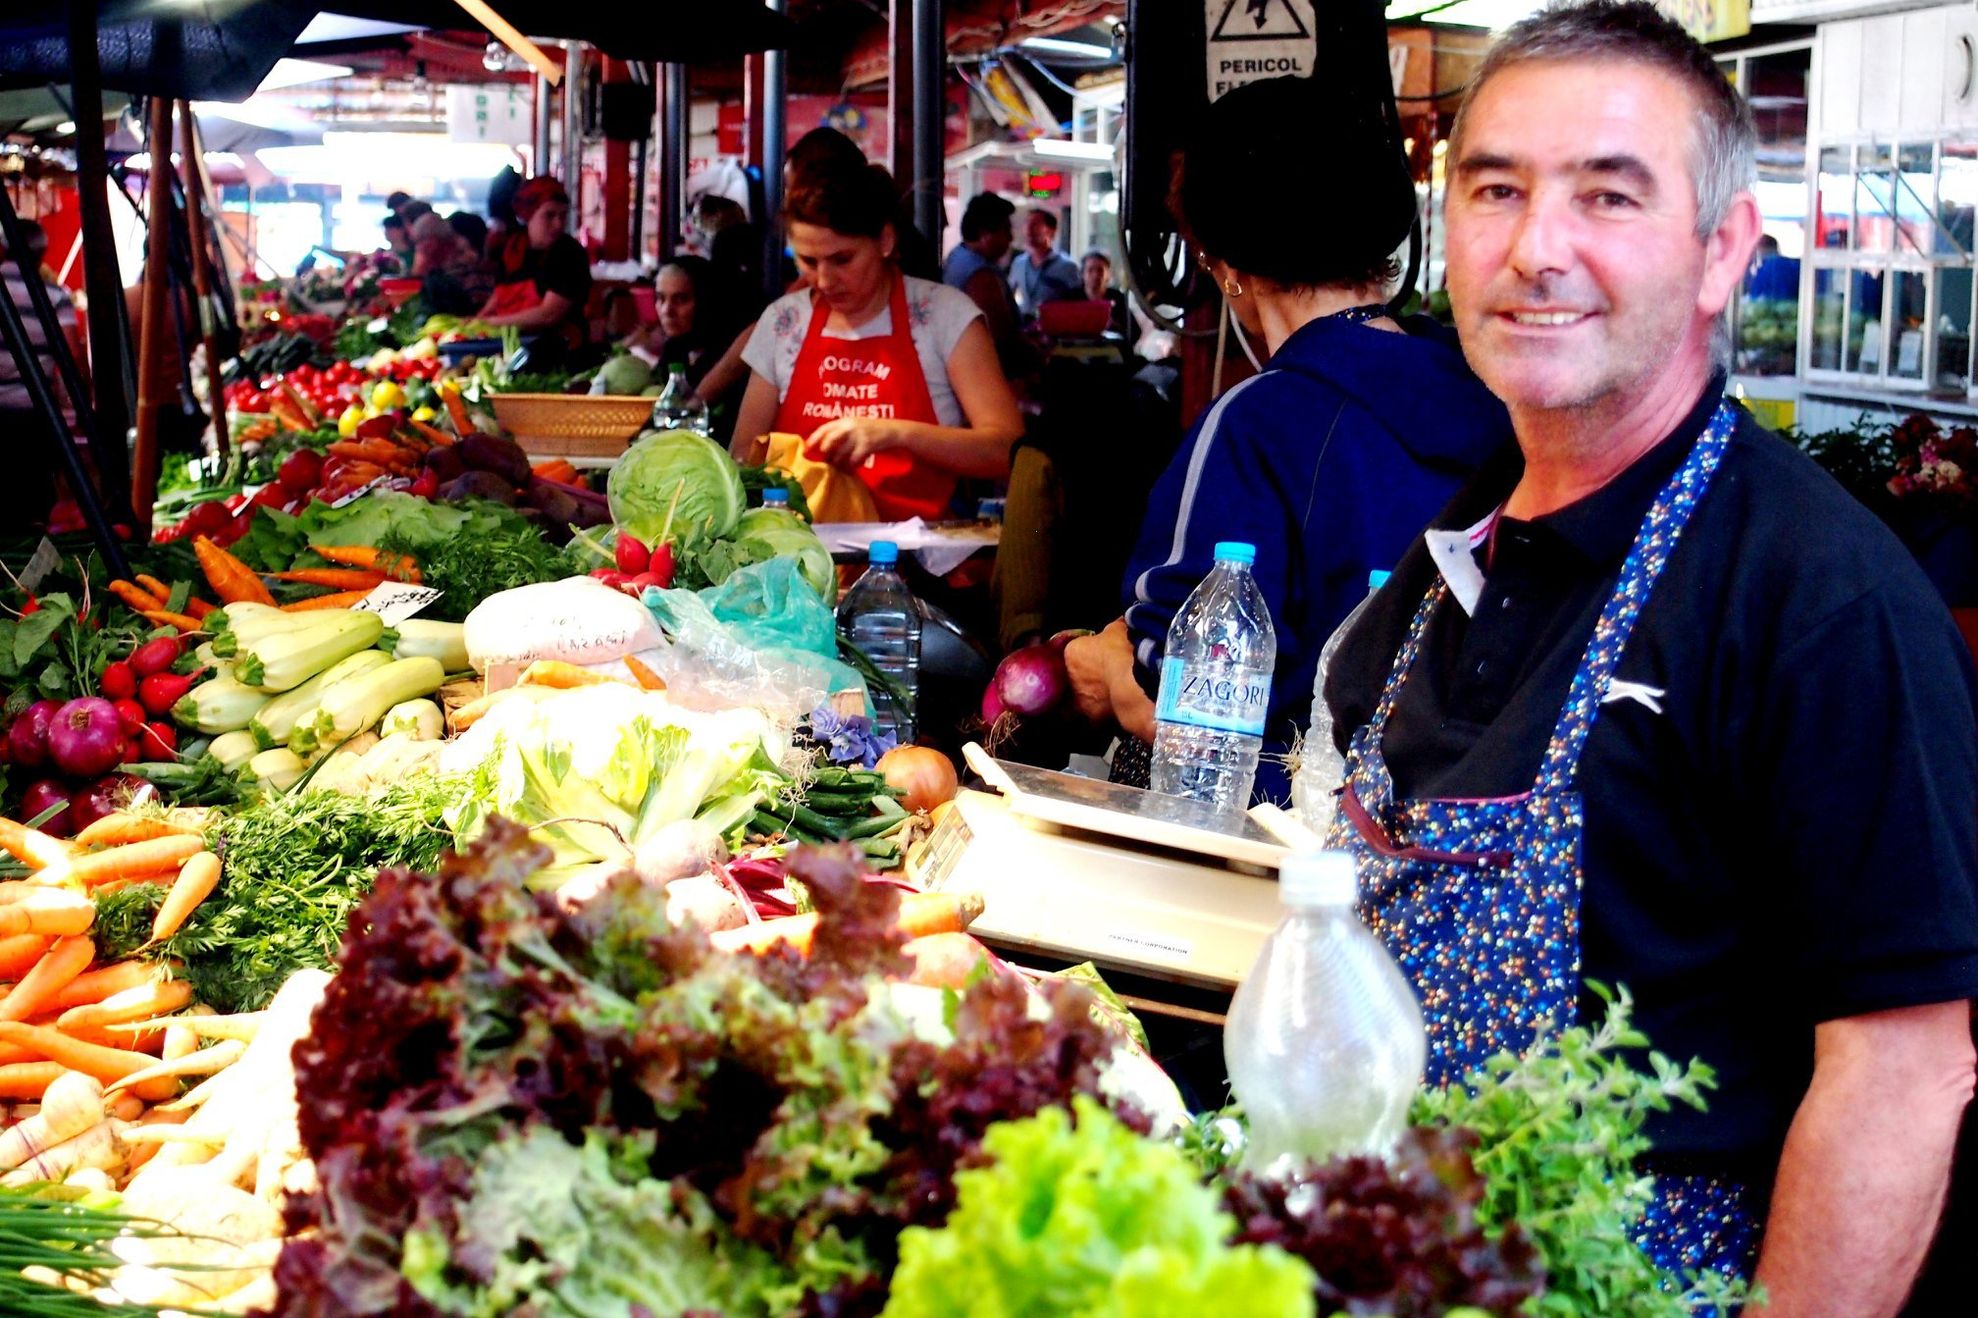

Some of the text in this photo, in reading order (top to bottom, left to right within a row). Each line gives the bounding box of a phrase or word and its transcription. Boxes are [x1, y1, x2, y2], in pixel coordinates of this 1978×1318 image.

[1220, 58, 1302, 73] PERICOL
[1183, 676, 1265, 707] ZAGORI
[1140, 941, 1188, 954] CORPORATION
